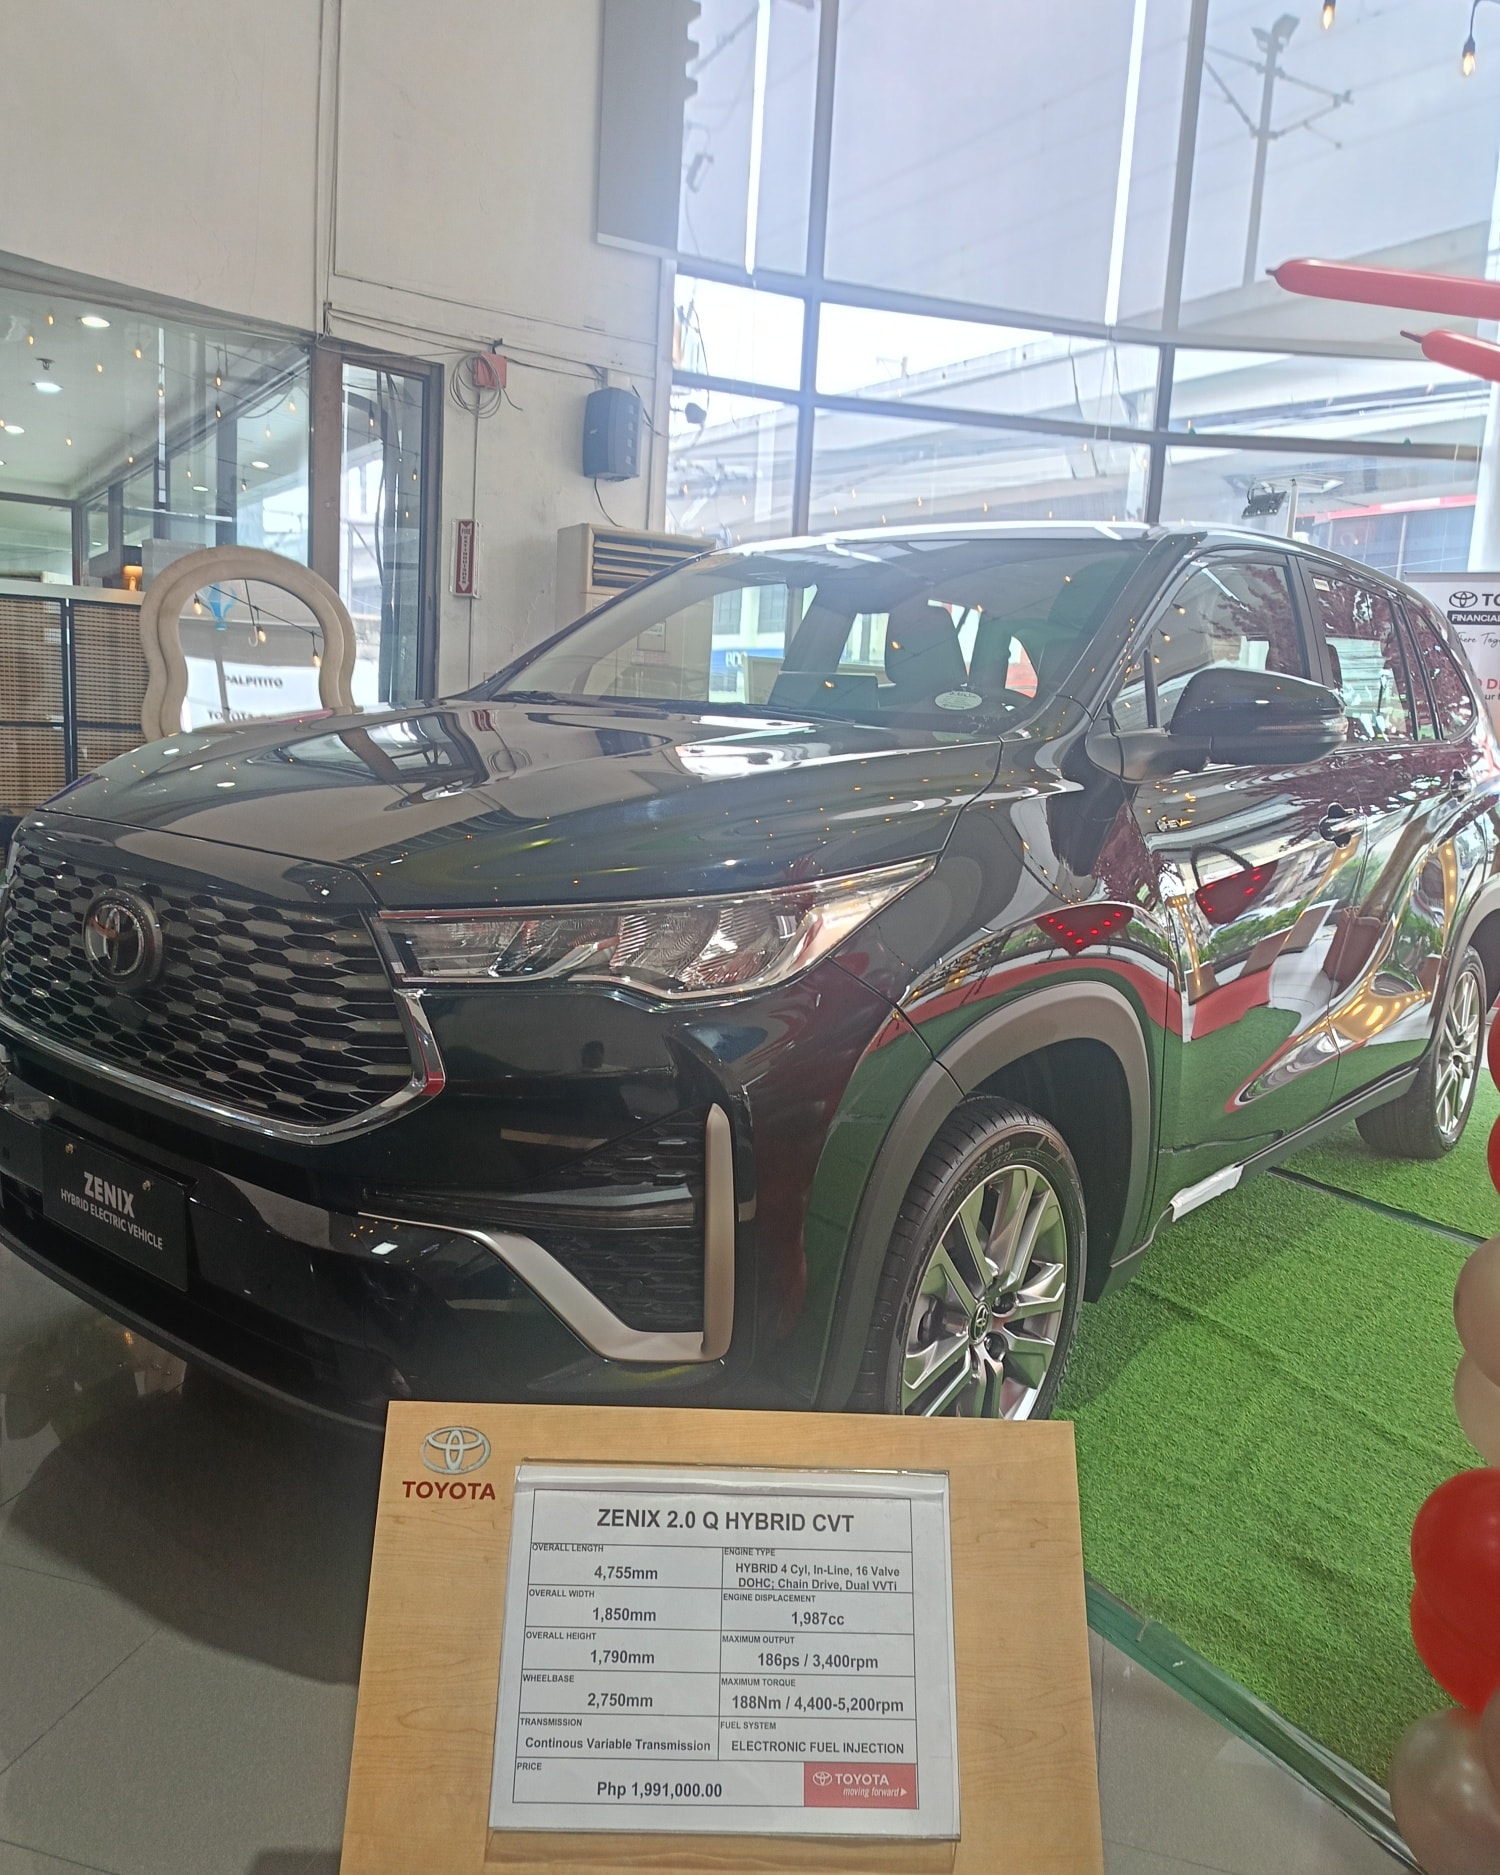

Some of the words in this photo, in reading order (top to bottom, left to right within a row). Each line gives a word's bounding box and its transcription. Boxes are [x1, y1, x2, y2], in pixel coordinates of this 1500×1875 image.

[84, 1171, 135, 1218] ZENIX
[61, 1188, 89, 1212] HYBRID
[90, 1203, 127, 1232] ELECTRIC
[128, 1222, 163, 1250] VEHICLE
[402, 1481, 496, 1500] TOYOTA
[597, 1509, 661, 1528] ZENIX
[667, 1511, 696, 1529] 2.0
[703, 1511, 719, 1531] Q
[725, 1512, 805, 1532] HYBRID
[812, 1514, 854, 1533] CVT
[531, 1543, 569, 1552] OVERALL
[571, 1544, 604, 1553] LENGTH
[724, 1547, 754, 1556] ENGINE
[755, 1548, 776, 1557] TYPE
[594, 1565, 658, 1581] 4,755mm
[735, 1562, 778, 1574] HYBRID
[781, 1563, 788, 1575] 4
[790, 1564, 811, 1577] Cyl,
[813, 1565, 853, 1577] In-Line,
[856, 1565, 868, 1576] 16
[871, 1566, 900, 1577] Valve
[738, 1577, 775, 1590] DOHC;
[778, 1578, 809, 1590] Chain
[811, 1579, 843, 1591] Drive,
[845, 1580, 870, 1591] Dual
[872, 1581, 898, 1591] VVTi
[528, 1588, 567, 1598] OVERALL
[569, 1590, 595, 1598] WIDTH
[723, 1593, 753, 1602] ENGINE
[754, 1594, 816, 1603] DISPLACEMENT
[592, 1607, 656, 1623] 1,850mm
[791, 1611, 845, 1627] 1,987cc
[525, 1631, 564, 1640] OVERALL
[566, 1632, 597, 1641] HEIGHT
[722, 1635, 761, 1644] MAXIMUM
[762, 1635, 796, 1644] OUTPUT
[590, 1649, 655, 1665] 1,790mm
[757, 1653, 800, 1670] 186ps
[803, 1653, 809, 1667] /
[812, 1654, 879, 1671] 3,400rpm
[522, 1674, 575, 1683] WHEELBASE
[721, 1678, 760, 1686] MAXIMUM
[762, 1678, 796, 1687] TORQUE
[587, 1692, 653, 1709] 2,750mm
[732, 1695, 781, 1710] 188Nm
[785, 1696, 791, 1710] /
[794, 1696, 904, 1715] 4,400-5,200rpm
[519, 1717, 583, 1727] TRANSMISSION
[720, 1721, 742, 1730] FUEL
[743, 1721, 777, 1730] SYSTEM
[525, 1737, 583, 1749] Continous
[587, 1737, 632, 1750] Variable
[635, 1738, 711, 1751] Transmission
[731, 1740, 807, 1753] ELECTRONIC
[809, 1741, 840, 1753] FUEL
[843, 1742, 904, 1754] INJECTION
[516, 1761, 542, 1771] PRICE
[834, 1773, 889, 1786] TOYOTA
[597, 1781, 627, 1799] Php
[631, 1782, 723, 1800] 1,991,000.00
[843, 1786, 870, 1798] moving
[871, 1787, 900, 1797] forward
